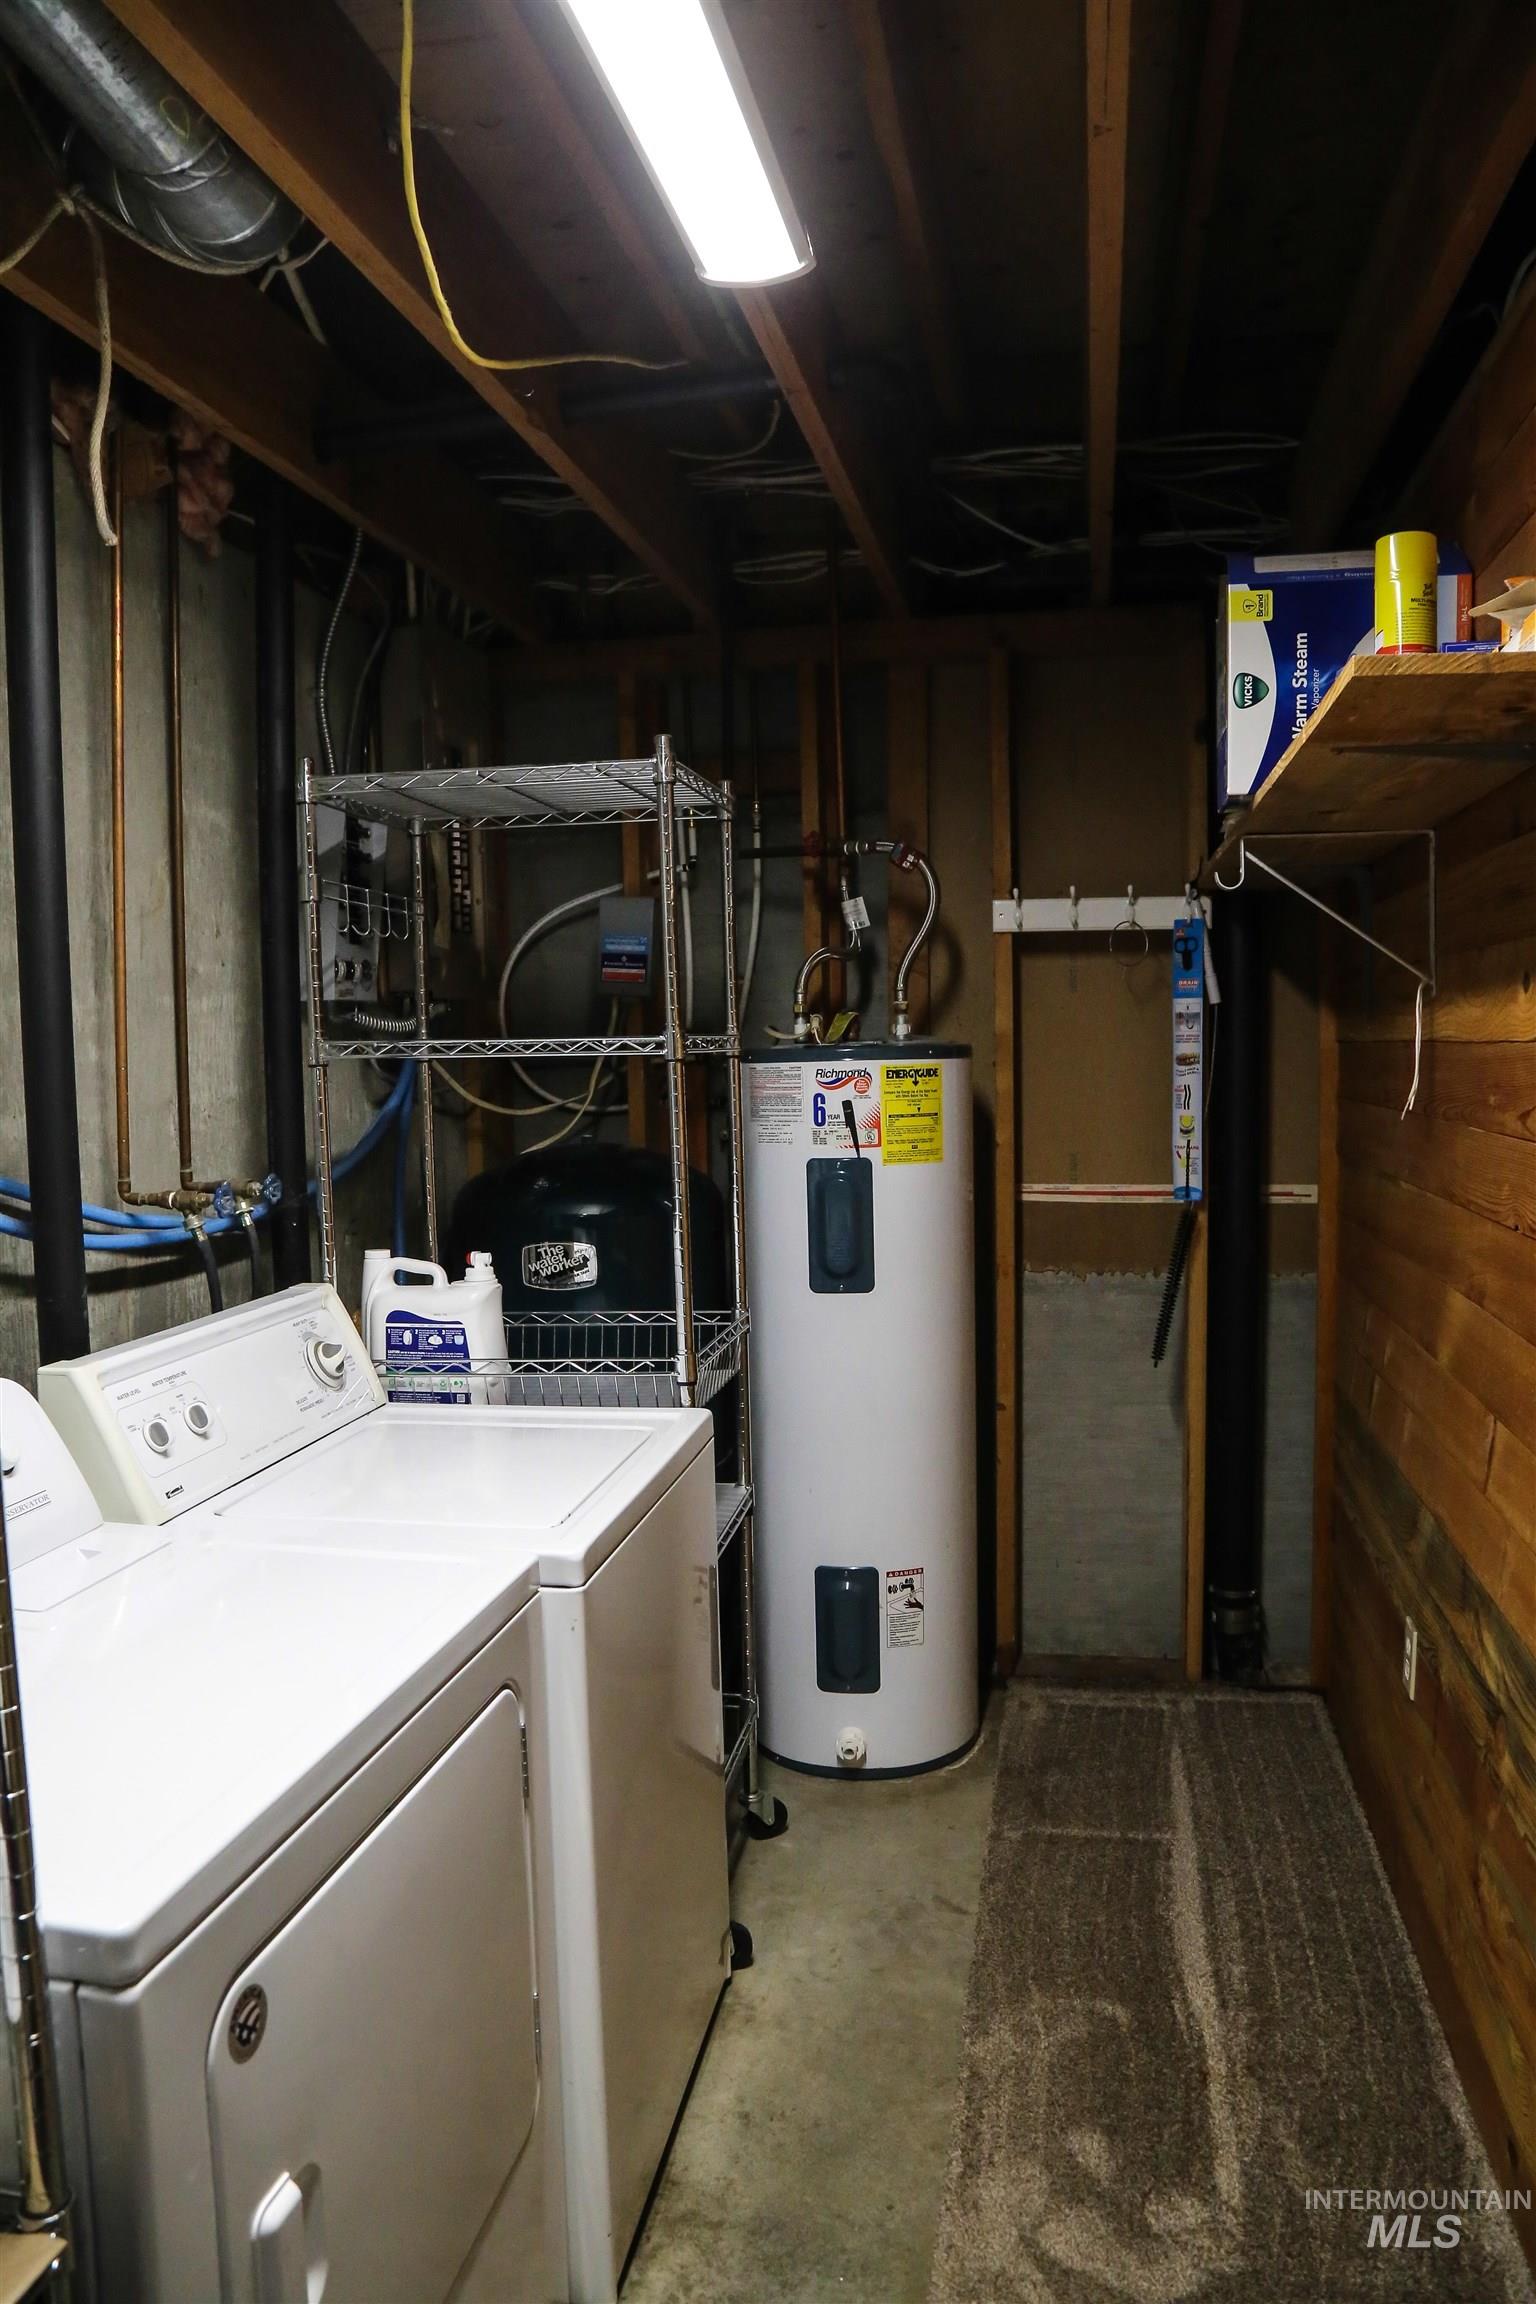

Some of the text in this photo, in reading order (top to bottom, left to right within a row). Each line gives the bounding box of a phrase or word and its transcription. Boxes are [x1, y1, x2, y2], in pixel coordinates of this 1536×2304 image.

[1256, 593, 1264, 617] Brand
[1291, 632, 1308, 688] Steam
[1243, 675, 1253, 707] VICKS
[1311, 668, 1322, 710] Vaporizer
[815, 1067, 868, 1079] Richmond
[813, 1092, 826, 1127] 6
[528, 1253, 564, 1272] water
[537, 1244, 564, 1259] The
[539, 1254, 586, 1277] worker
[6, 1493, 51, 1517] SERVATOR
[894, 1568, 922, 1577] DANGER
